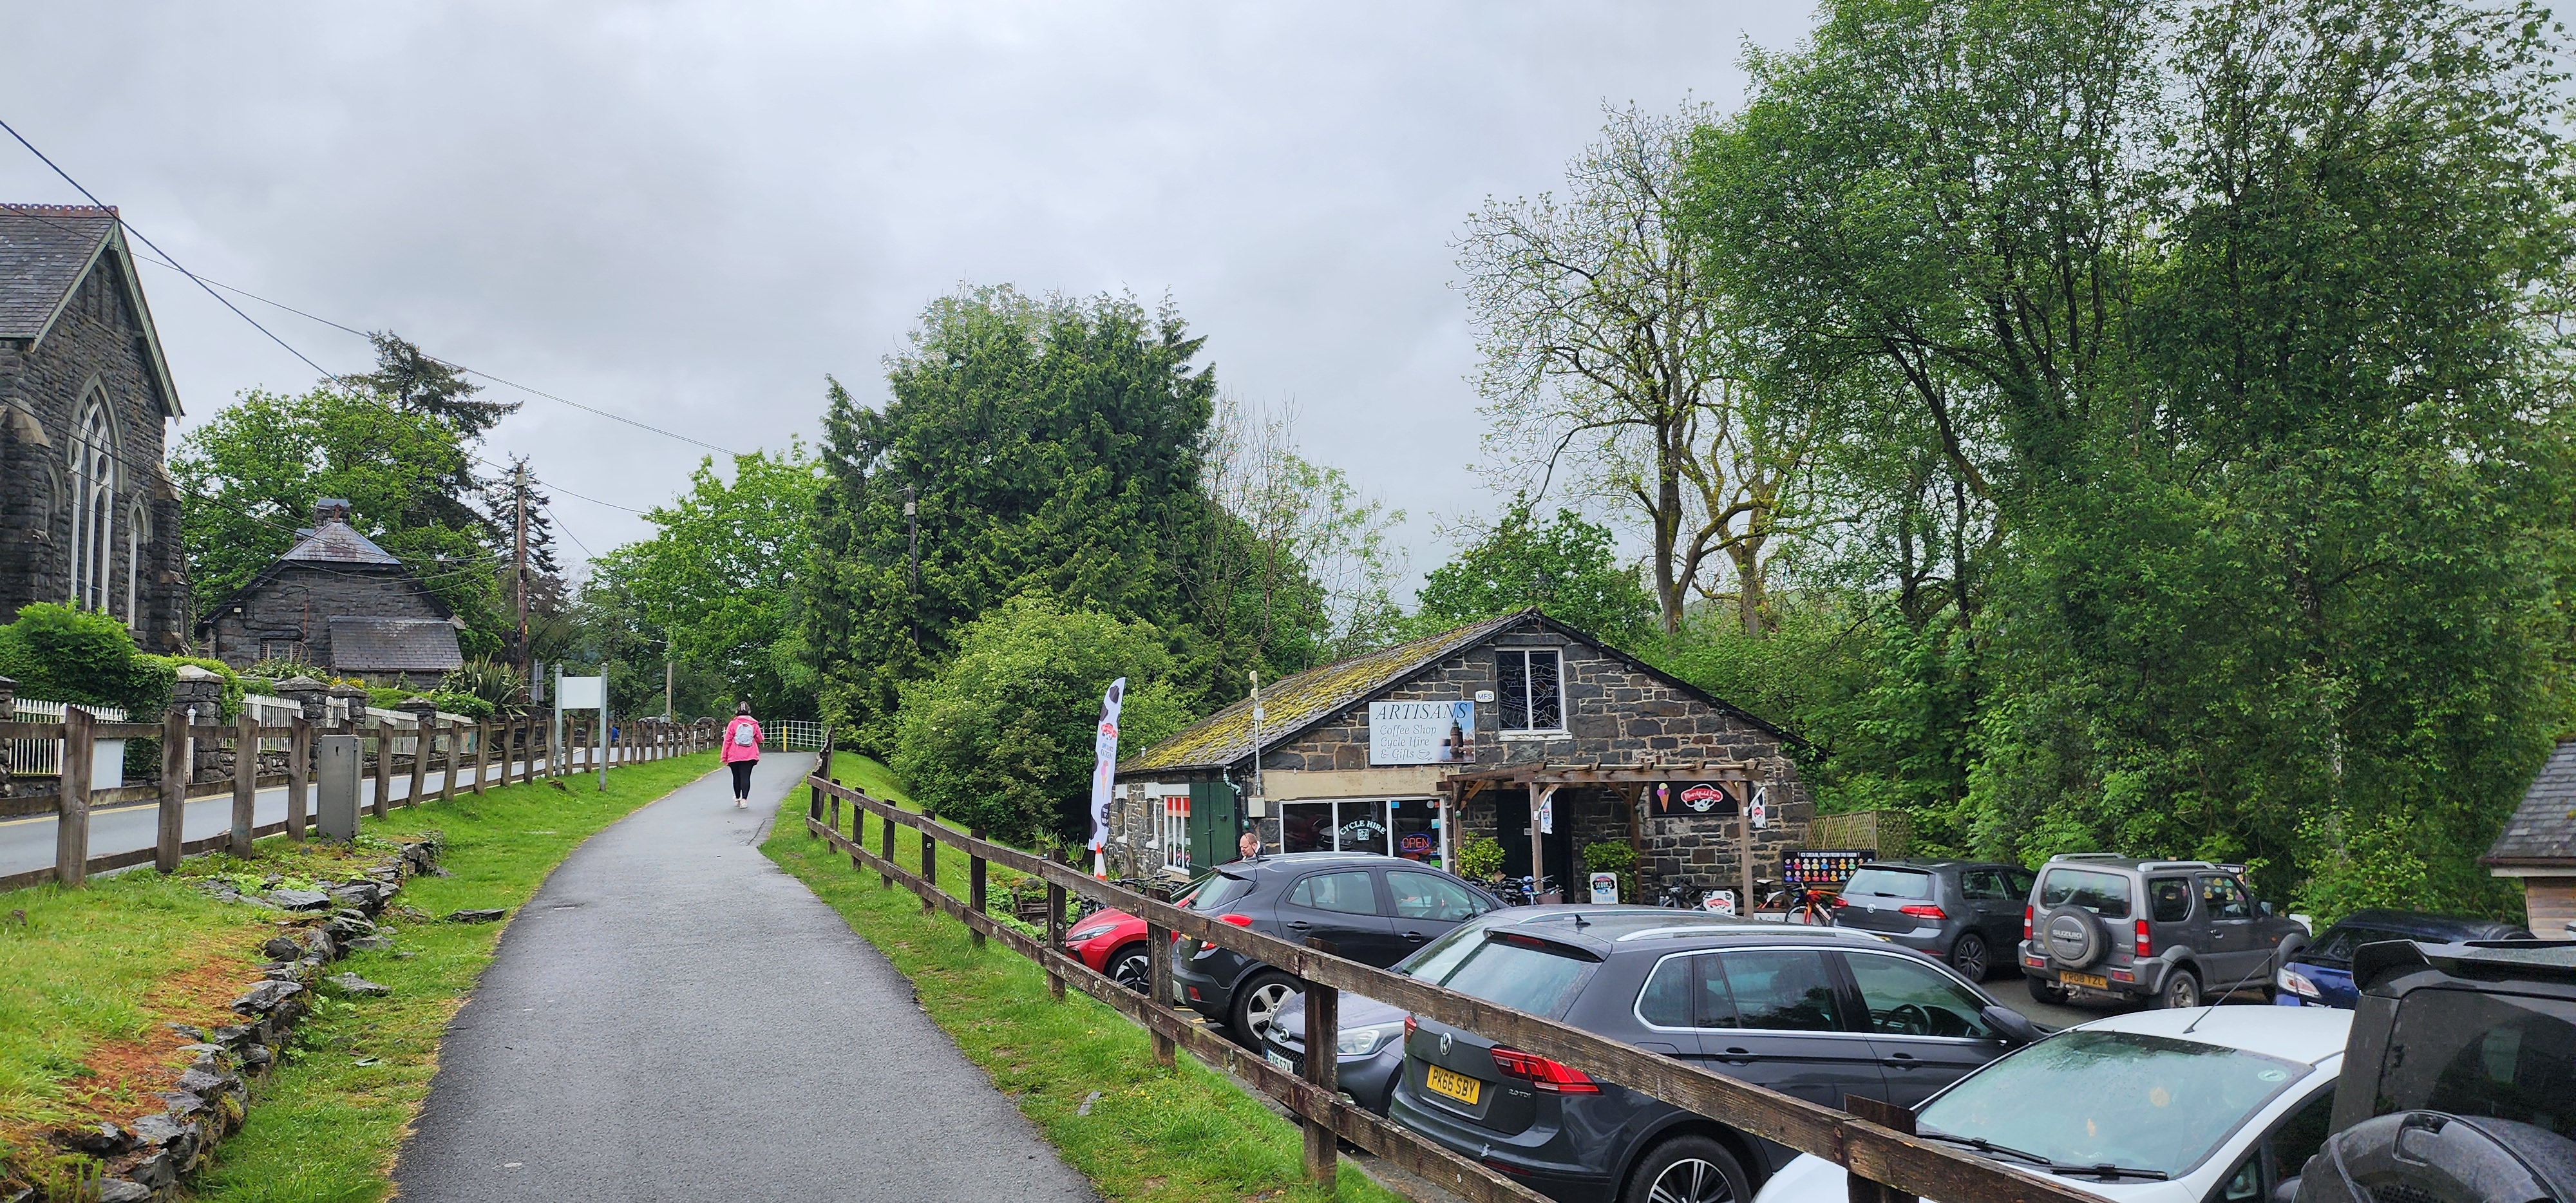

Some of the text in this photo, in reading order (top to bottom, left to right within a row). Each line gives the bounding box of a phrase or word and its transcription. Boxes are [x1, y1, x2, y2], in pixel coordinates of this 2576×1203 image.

[1375, 703, 1468, 720] ARTISANS
[1380, 724, 1437, 737] Coffee Shop
[1380, 736, 1429, 749] Cycle Hire
[1380, 748, 1414, 761] & Gifts
[1340, 820, 1387, 835] CYCLE HIRE
[1402, 837, 1430, 849] OPEN
[2052, 929, 2083, 941] SUZUKI
[1432, 1068, 1476, 1099] PK66 SBY
